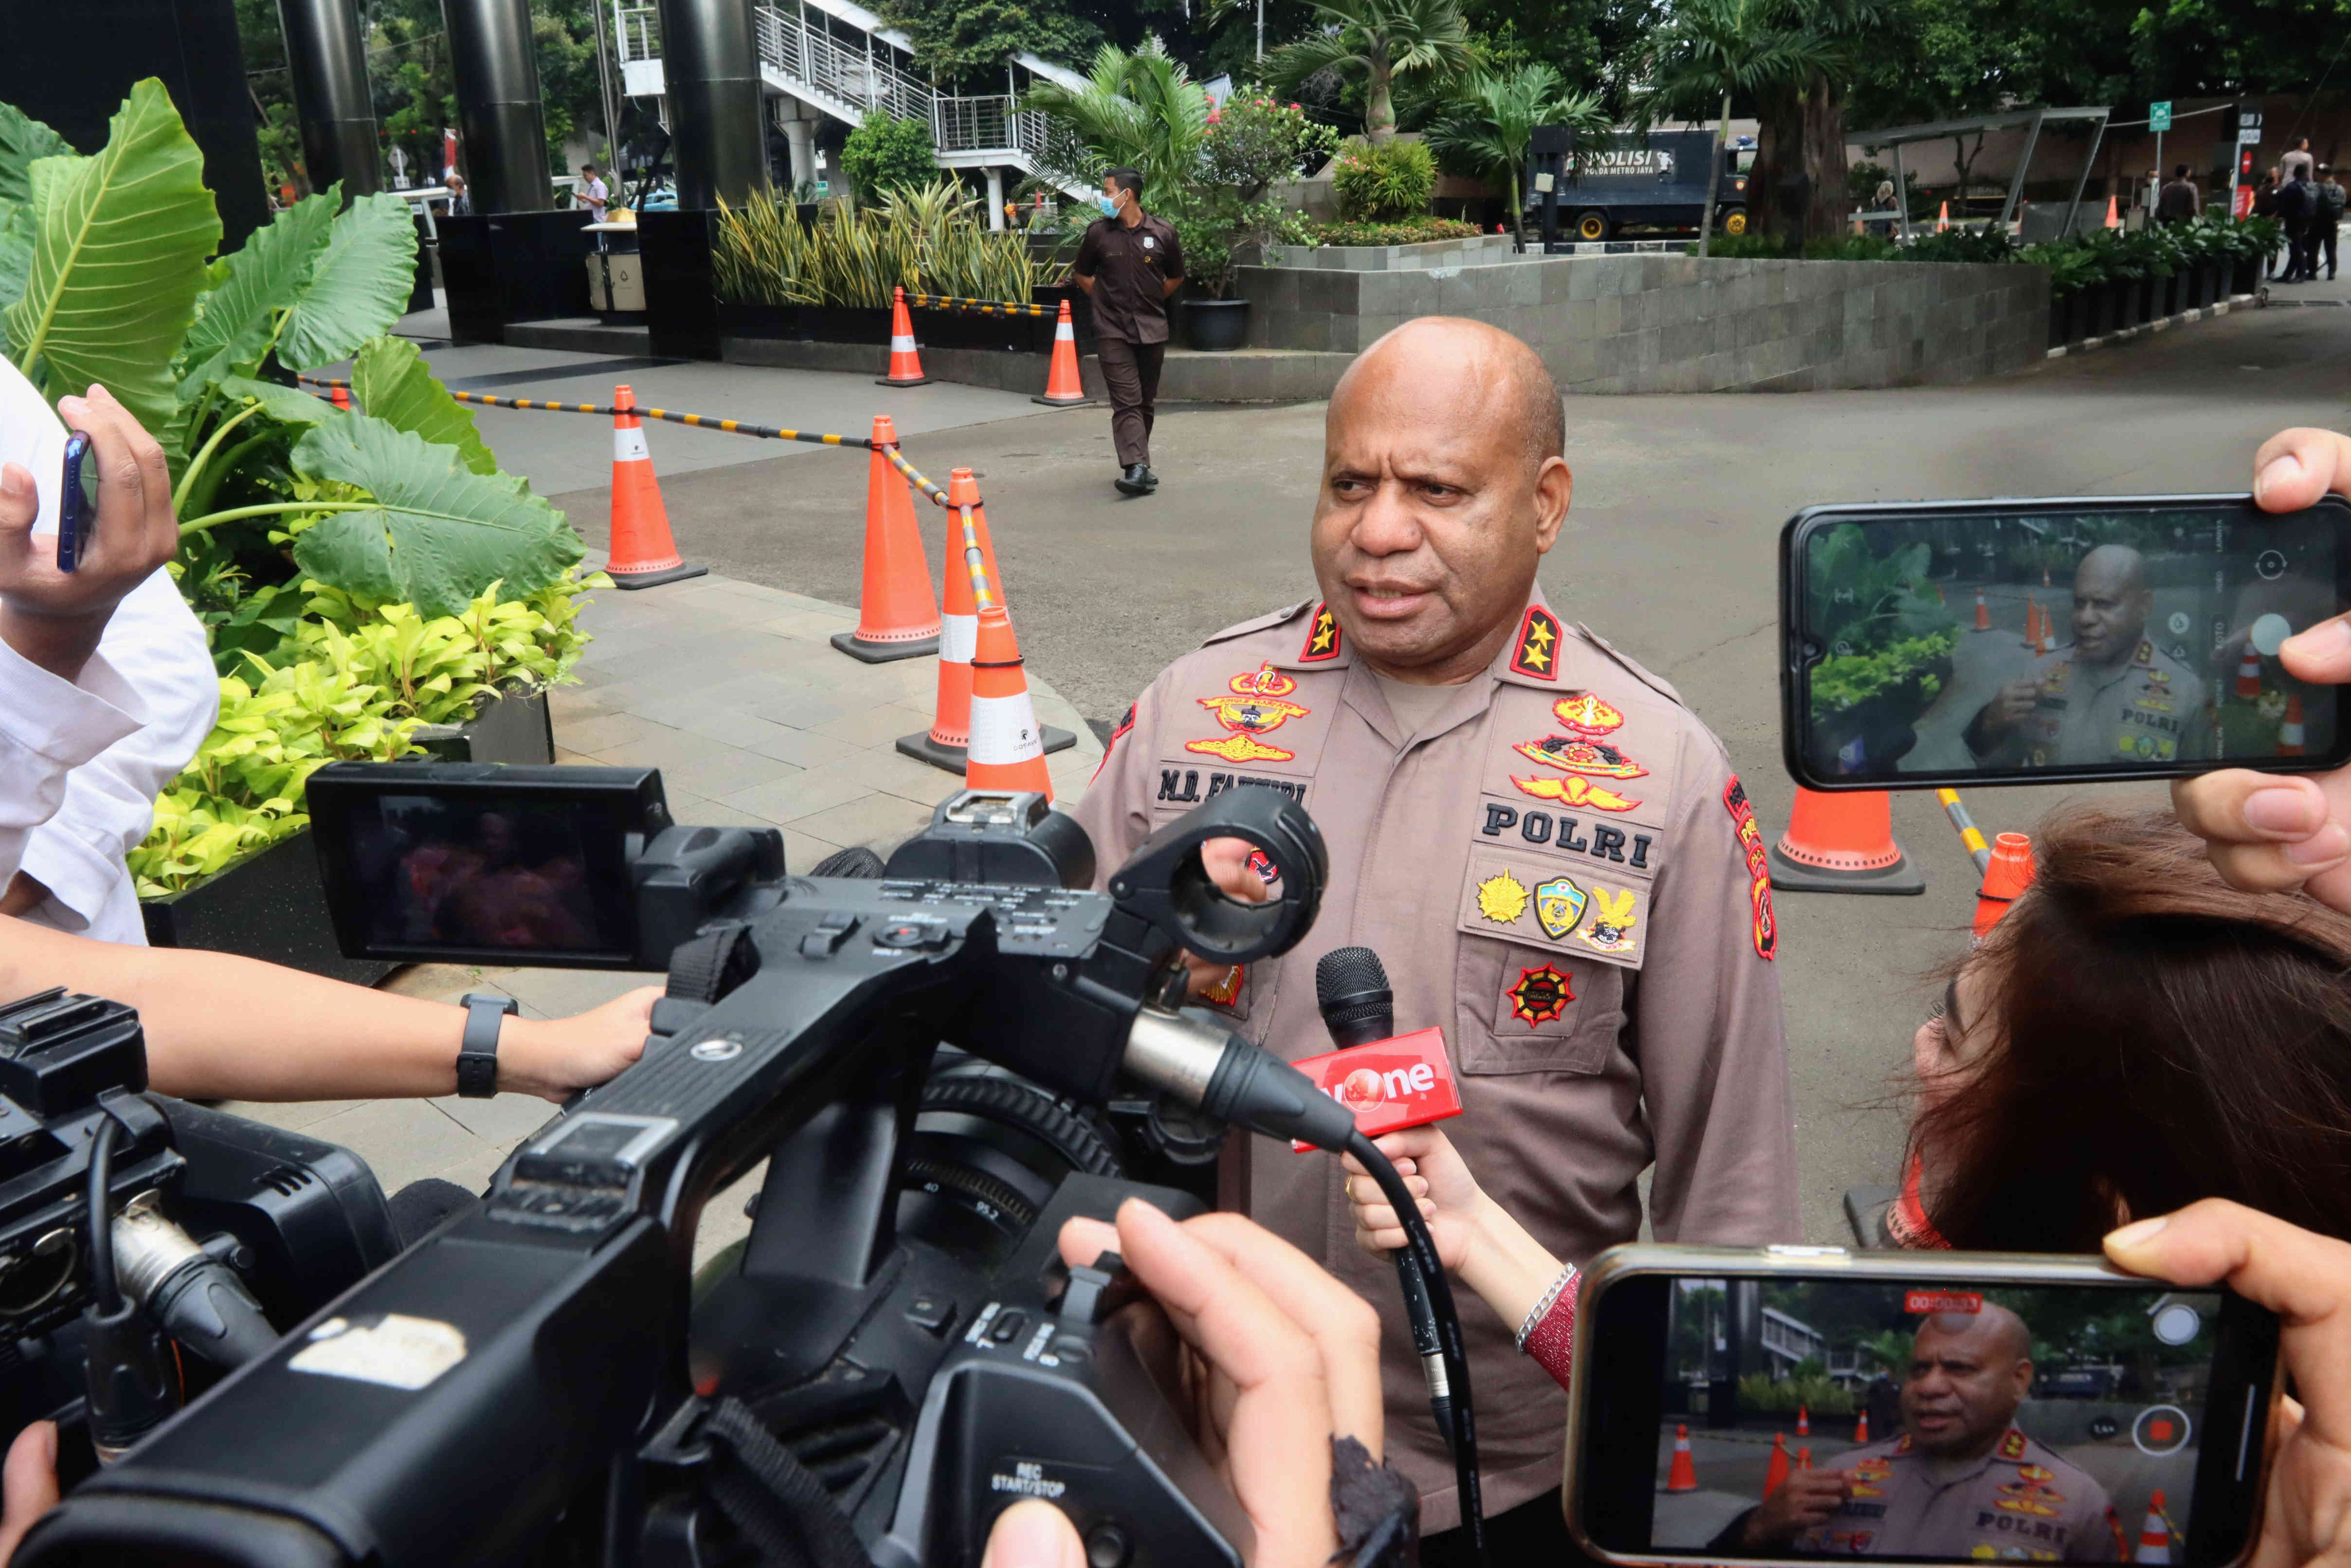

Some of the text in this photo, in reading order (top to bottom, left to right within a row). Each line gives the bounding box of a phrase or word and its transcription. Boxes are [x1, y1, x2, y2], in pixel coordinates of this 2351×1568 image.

[1588, 150, 1652, 166] POLISI
[1610, 166, 1635, 175] METRO
[2121, 708, 2179, 733] POLRI
[1204, 773, 1306, 806] FARI
[1482, 803, 1652, 868] POLRI
[1016, 1461, 1043, 1481] REC
[991, 1474, 1066, 1499] START/STOP
[1976, 1511, 2068, 1544] POLRI
